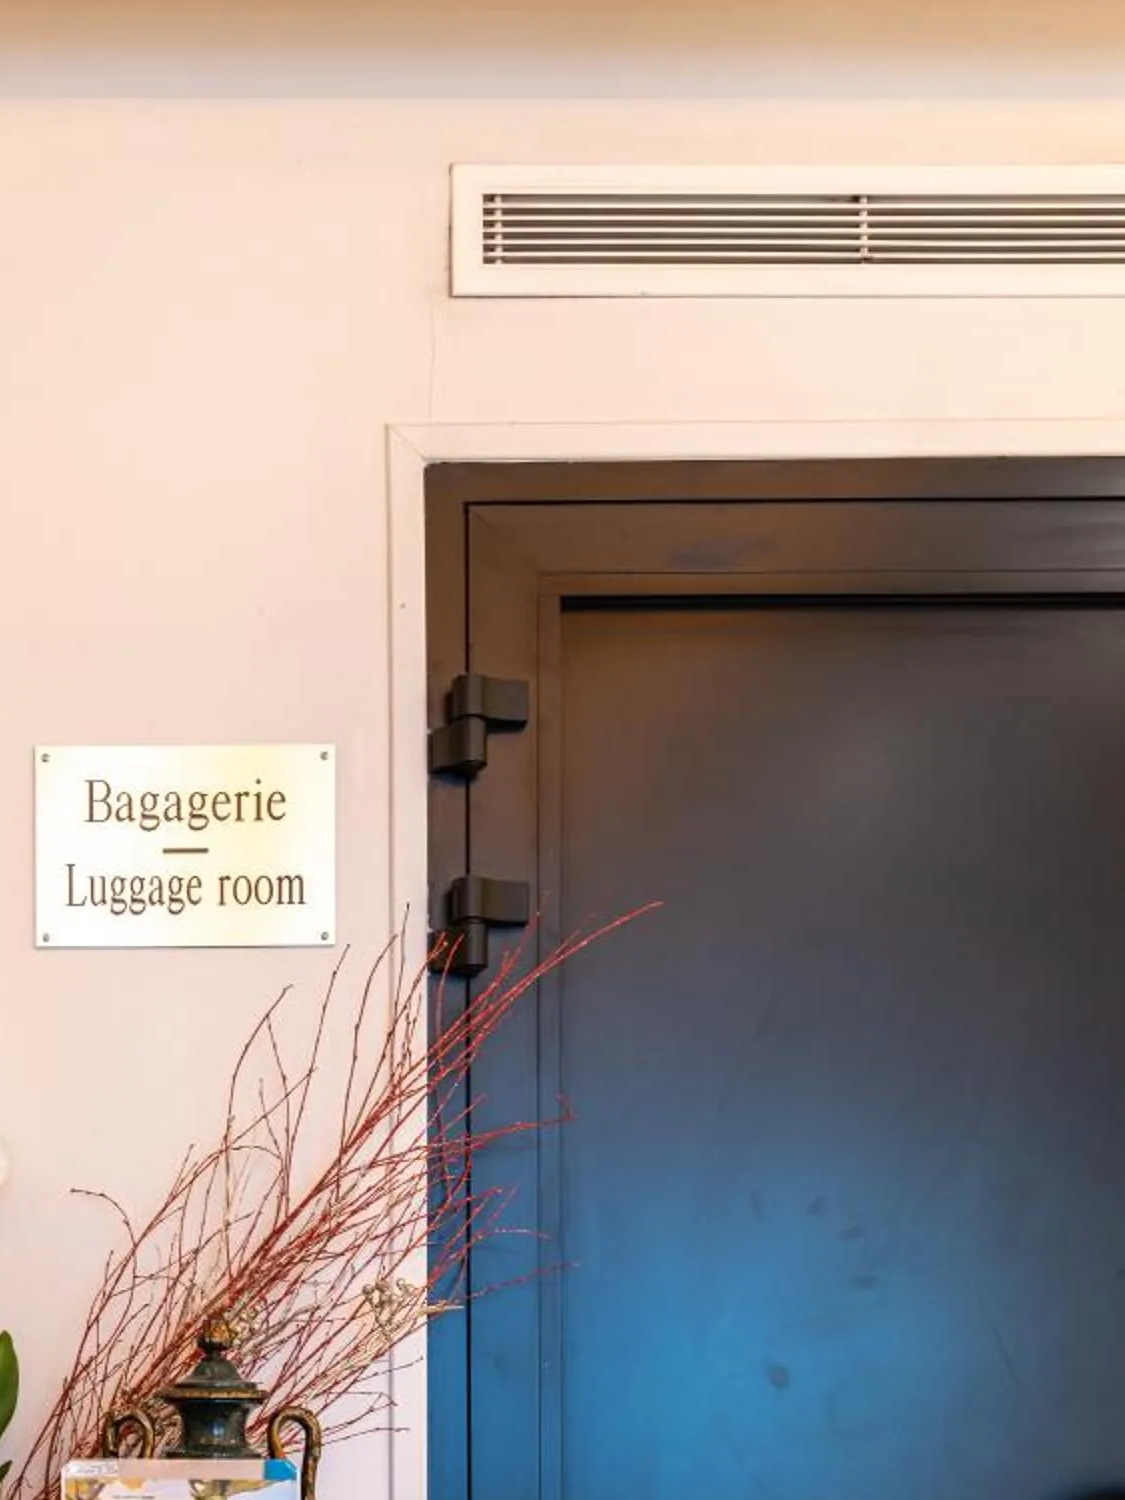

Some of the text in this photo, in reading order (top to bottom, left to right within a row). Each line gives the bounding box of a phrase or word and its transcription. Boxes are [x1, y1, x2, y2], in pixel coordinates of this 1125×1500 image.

[84, 778, 287, 831] Bagagerie
[65, 864, 307, 915] Luggage room
